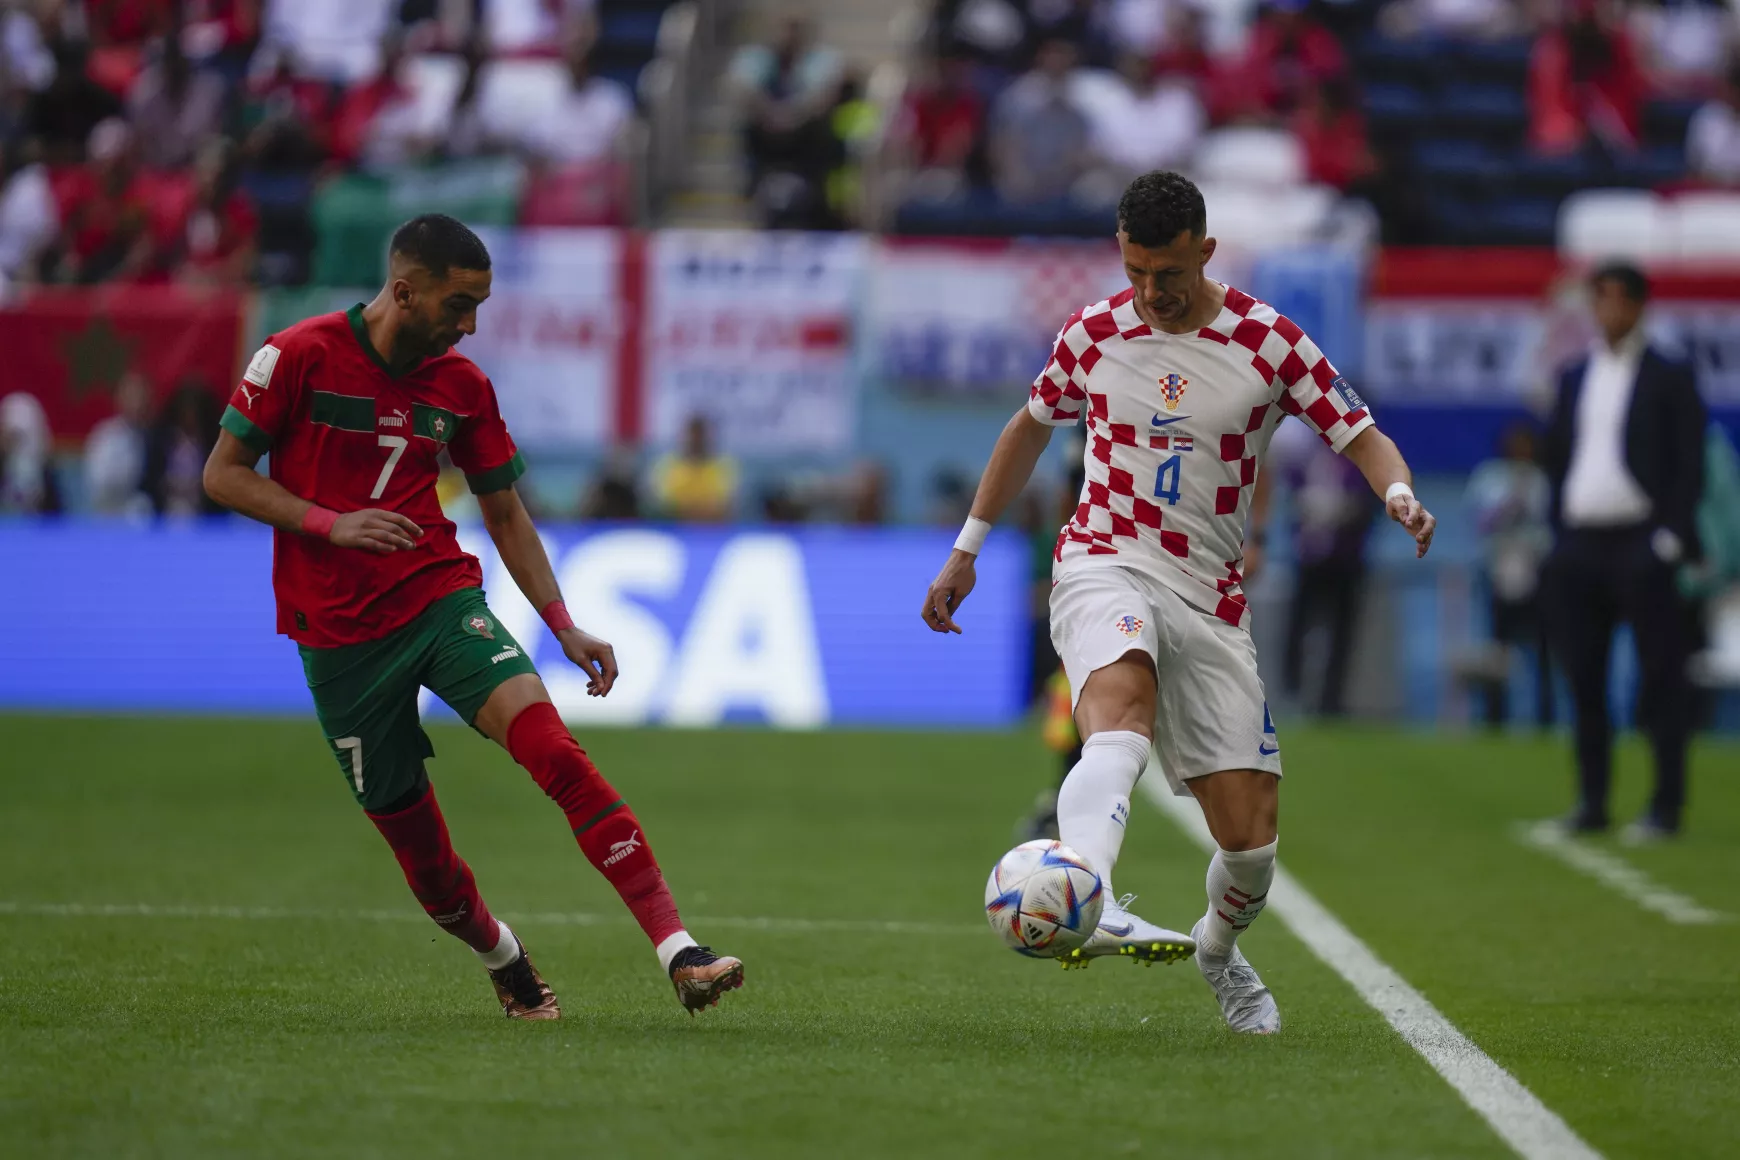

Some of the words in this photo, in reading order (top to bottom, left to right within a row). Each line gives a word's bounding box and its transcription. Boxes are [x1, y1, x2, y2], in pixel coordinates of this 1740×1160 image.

[378, 416, 403, 427] PUMA
[370, 434, 409, 499] 7
[1154, 455, 1181, 506] 4
[491, 650, 519, 664] PUMA
[334, 736, 364, 792] 7
[603, 844, 635, 868] PUMA
